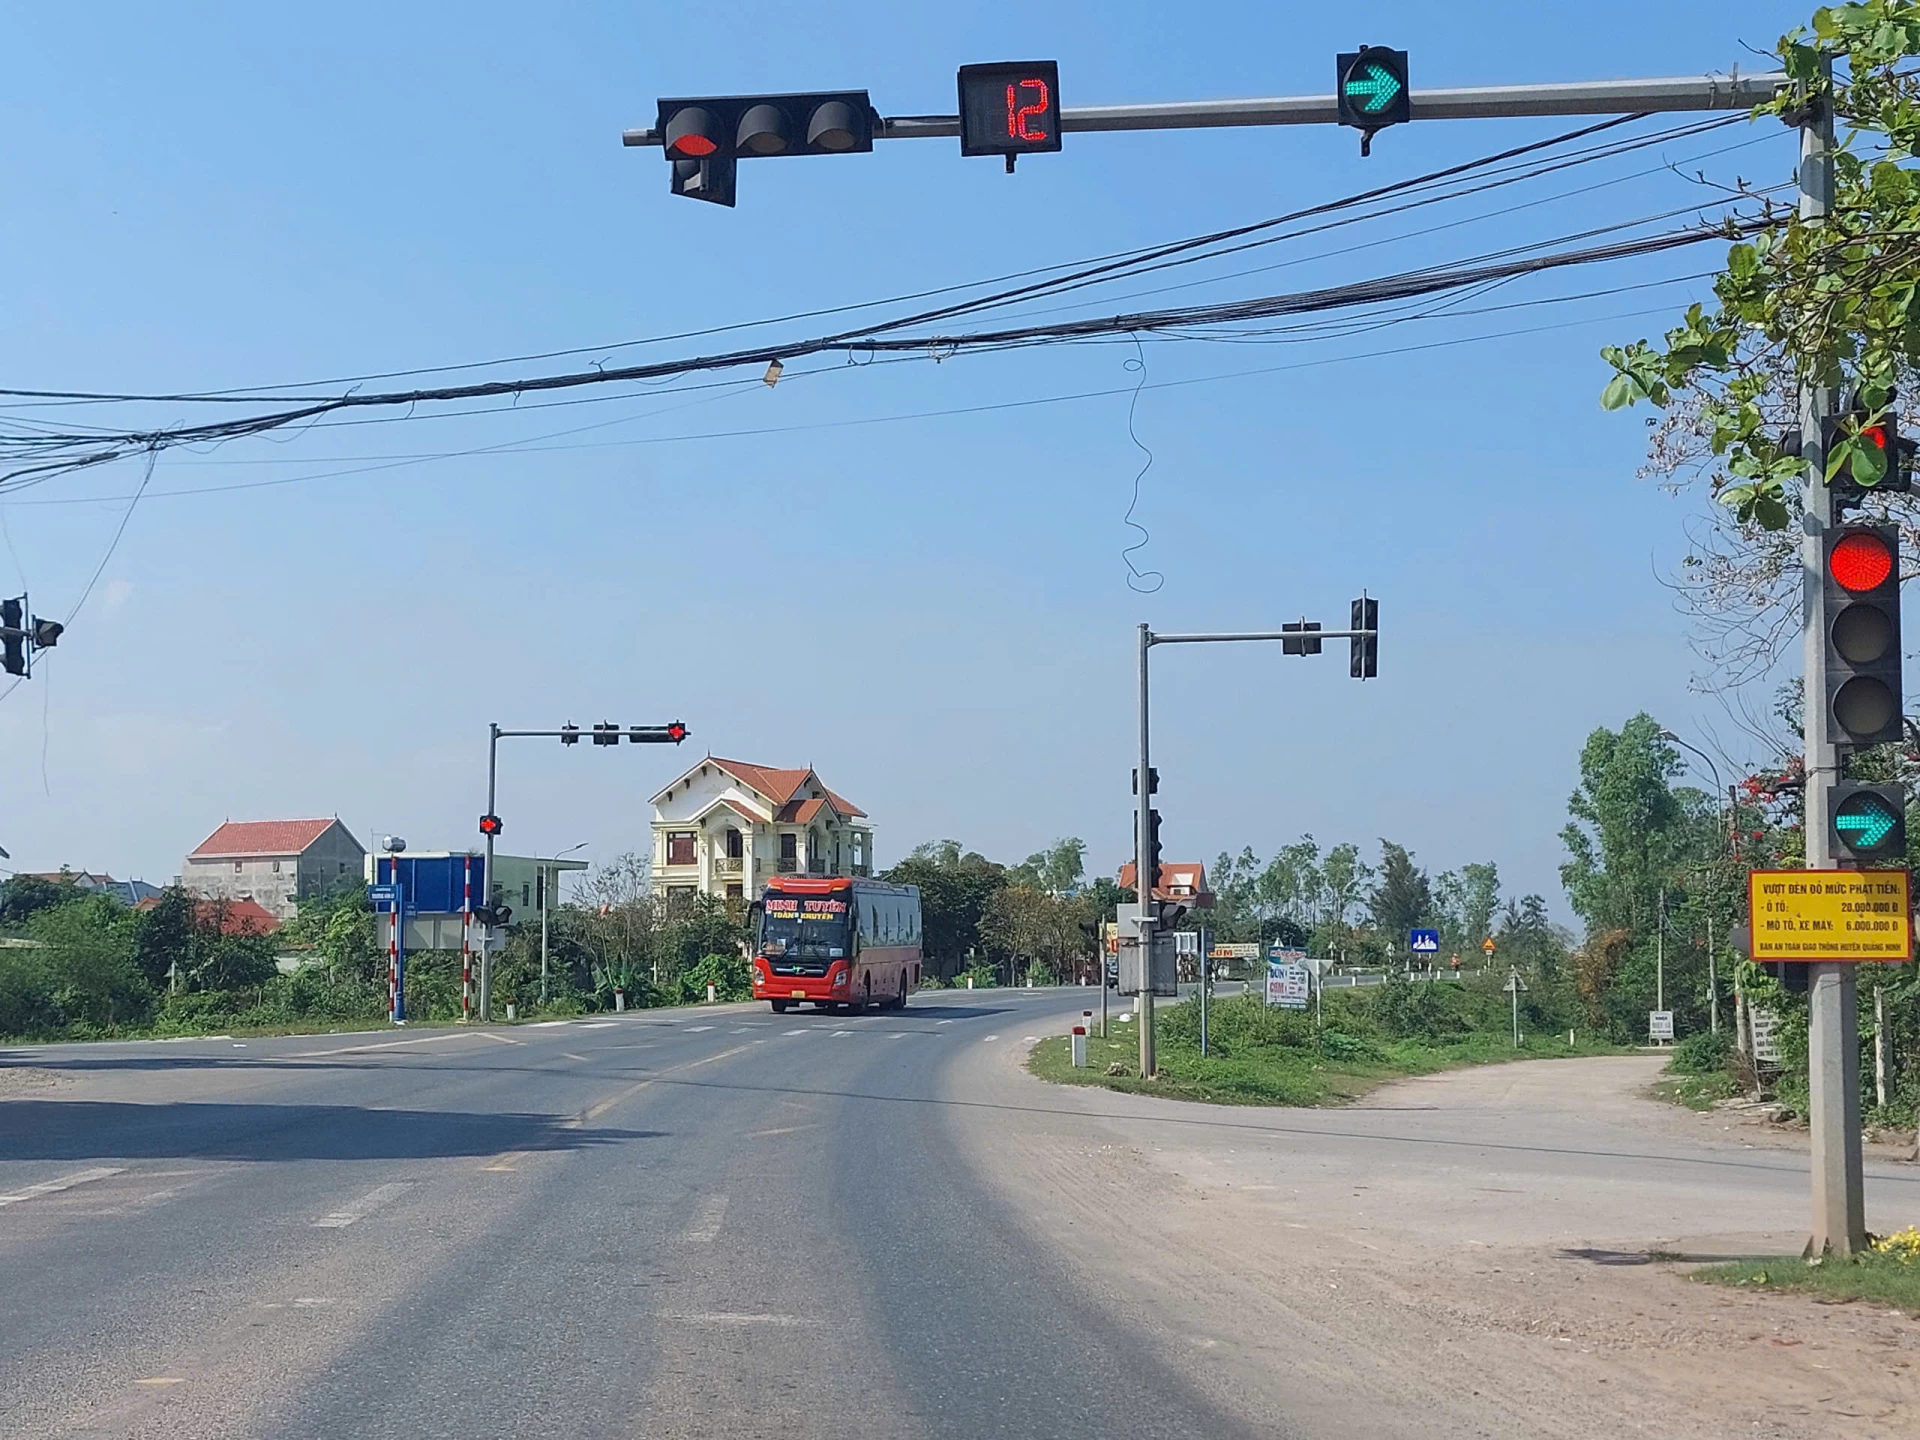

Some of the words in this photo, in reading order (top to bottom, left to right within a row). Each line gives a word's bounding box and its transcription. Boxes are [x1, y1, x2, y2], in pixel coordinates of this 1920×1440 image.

[1006, 79, 1049, 141] 12
[766, 900, 798, 910] MINH
[1842, 902, 1890, 912] 20.000.000
[1800, 920, 1810, 930] XE
[1846, 920, 1890, 930] 6.000.000
